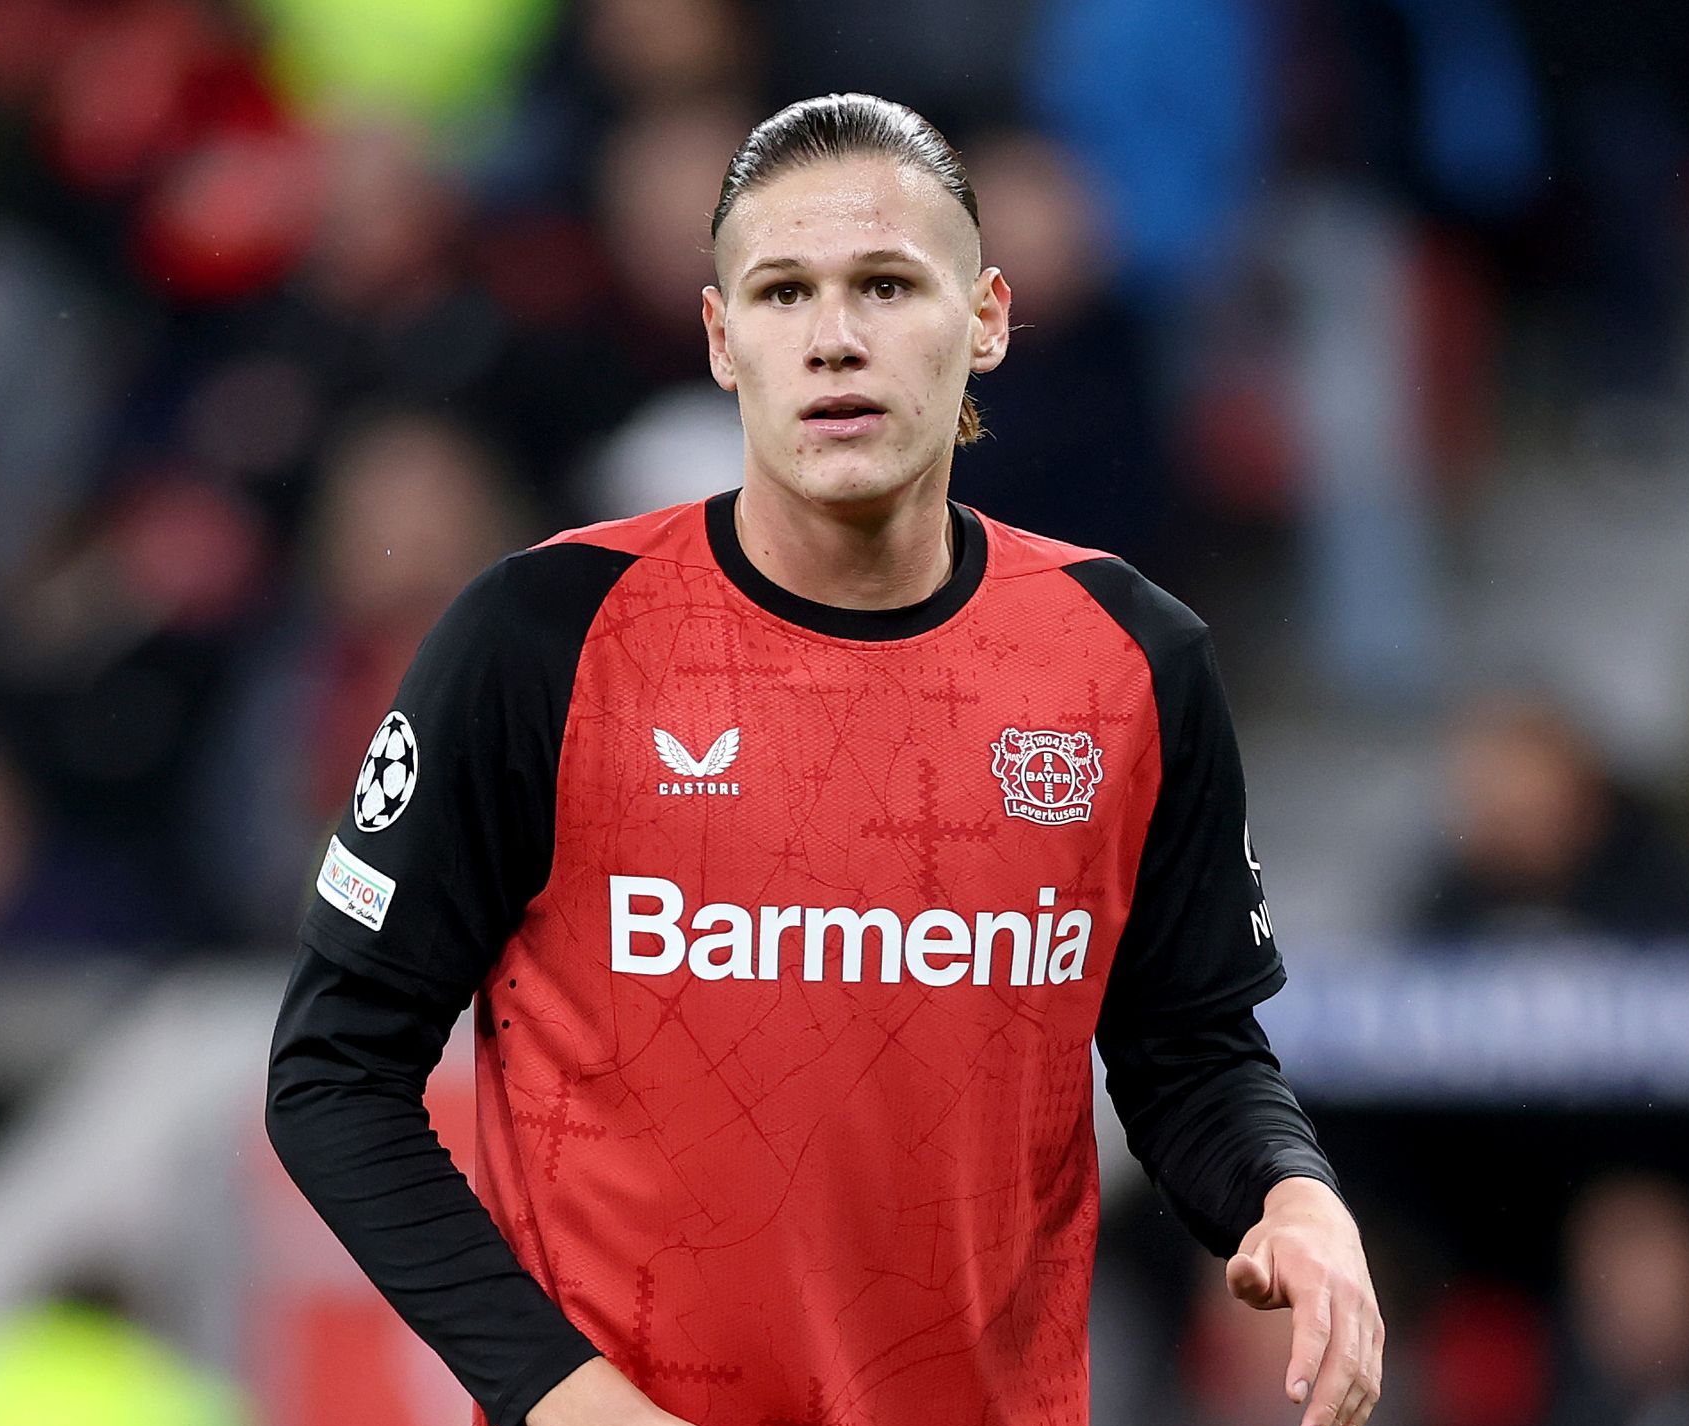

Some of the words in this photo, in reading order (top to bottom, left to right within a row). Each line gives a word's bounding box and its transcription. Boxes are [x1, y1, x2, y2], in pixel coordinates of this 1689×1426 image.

[1034, 736, 1060, 748] 1904
[1026, 771, 1071, 784] BAYER
[658, 782, 740, 796] CASTORE
[1012, 801, 1083, 821] Leverkusen
[609, 874, 1093, 988] Barmenia
